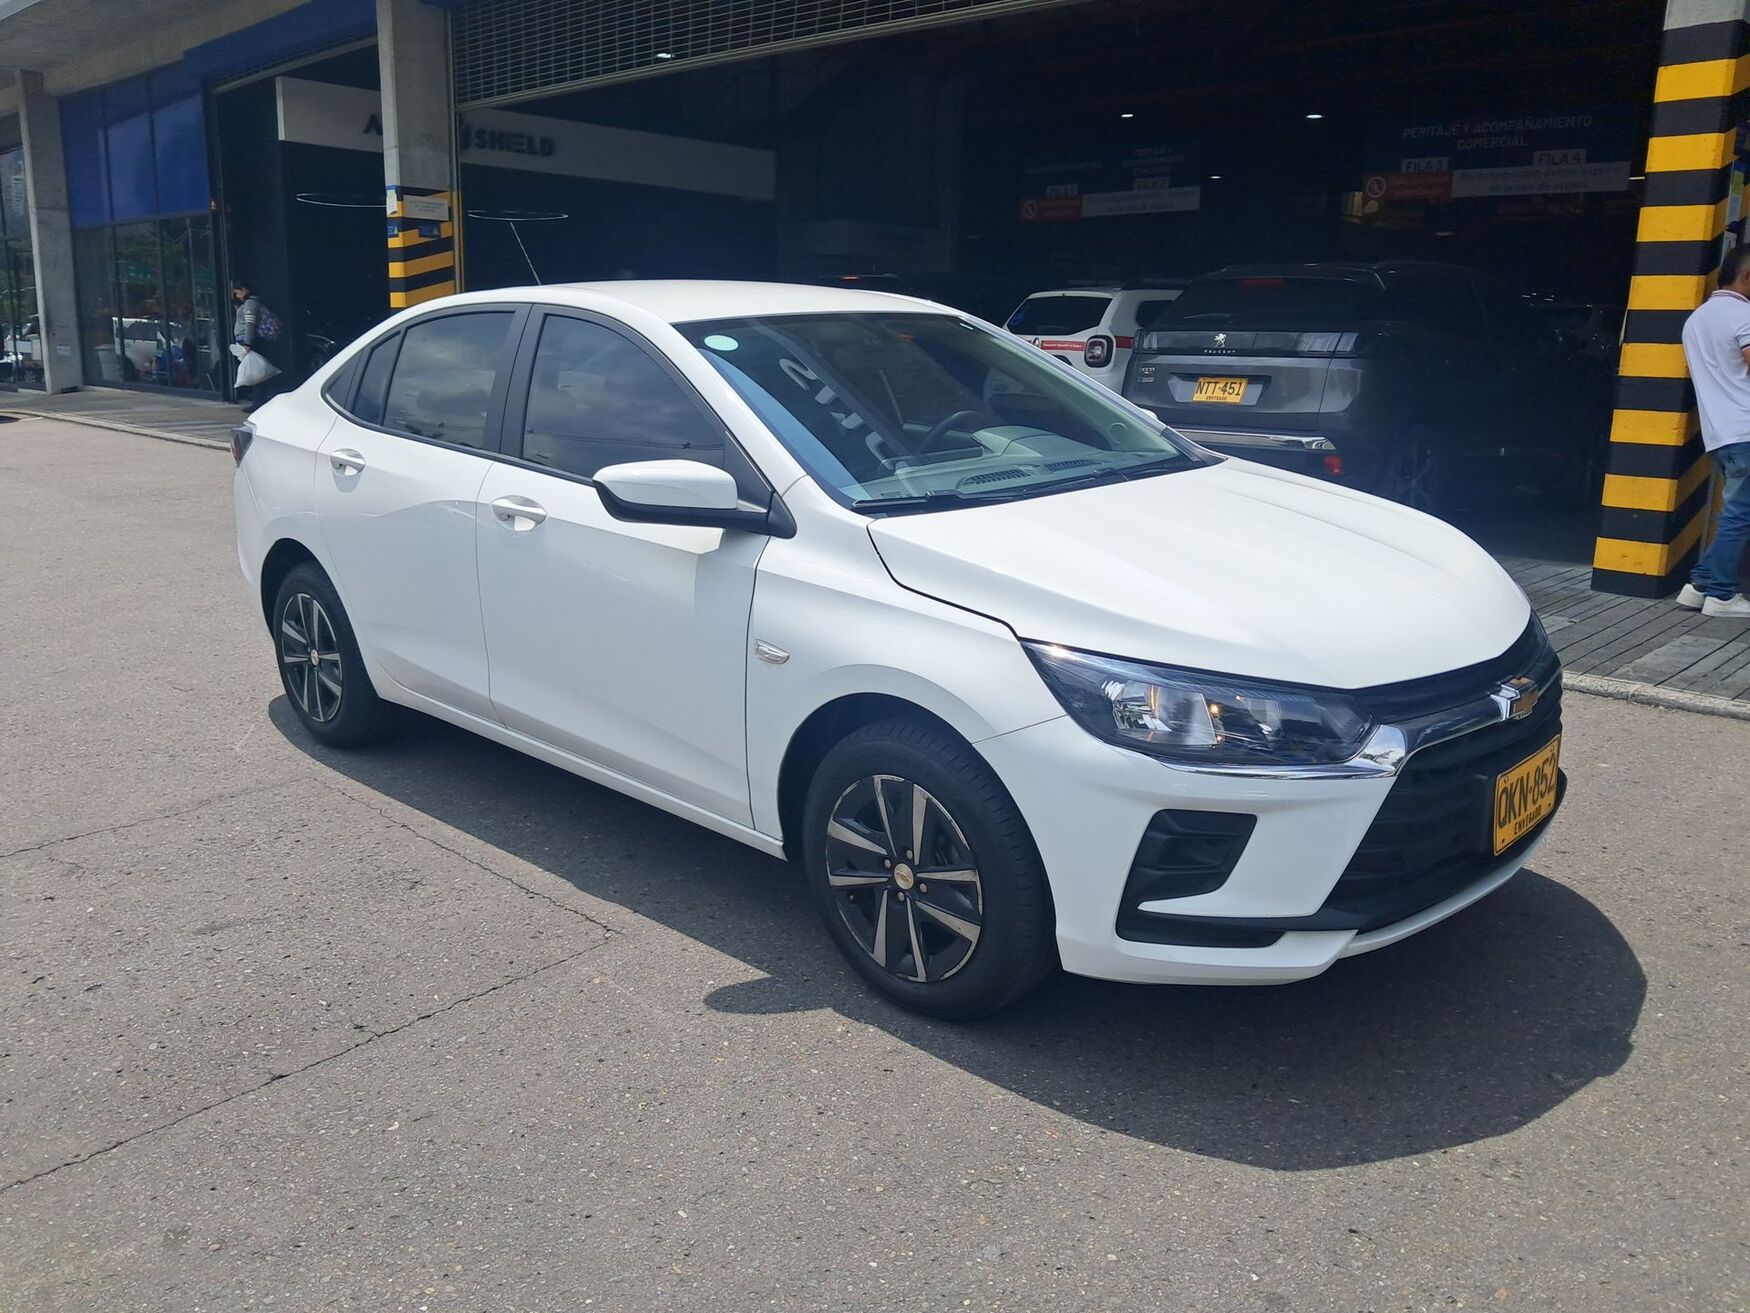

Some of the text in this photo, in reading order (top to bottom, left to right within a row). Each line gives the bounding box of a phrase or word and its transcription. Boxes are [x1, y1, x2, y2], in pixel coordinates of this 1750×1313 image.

[1402, 115, 1592, 139] PERITAJE Y ACOMPAÑAMIENTO
[474, 127, 556, 157] SHIELD
[1457, 134, 1529, 151] COMERCIAL
[1406, 158, 1445, 172] FILA 3
[1539, 151, 1582, 166] FILA 4
[1513, 804, 1542, 835] ENVIGADO
